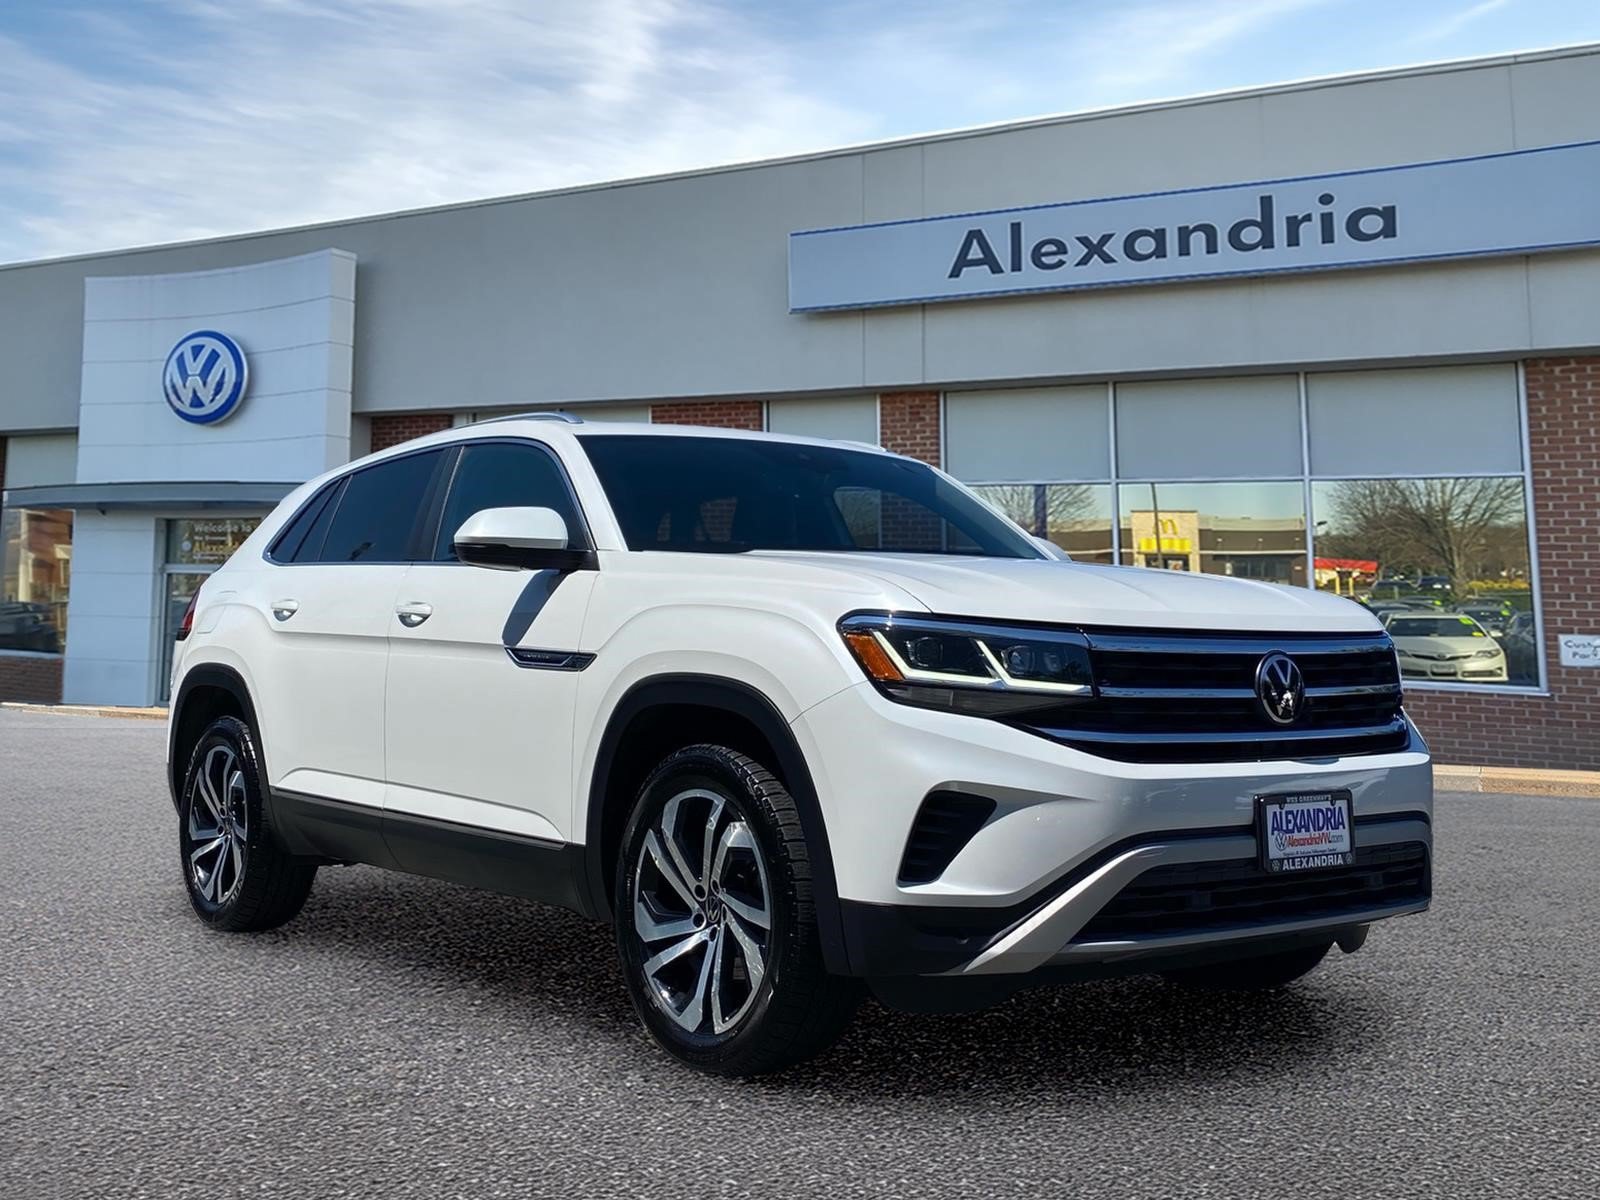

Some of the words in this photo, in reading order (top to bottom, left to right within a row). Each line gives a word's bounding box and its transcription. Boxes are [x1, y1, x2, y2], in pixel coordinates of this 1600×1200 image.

[948, 193, 1397, 279] Alexandria
[1271, 806, 1346, 836] ALEXANDRIA
[1282, 853, 1344, 871] ALEXANDRIA
